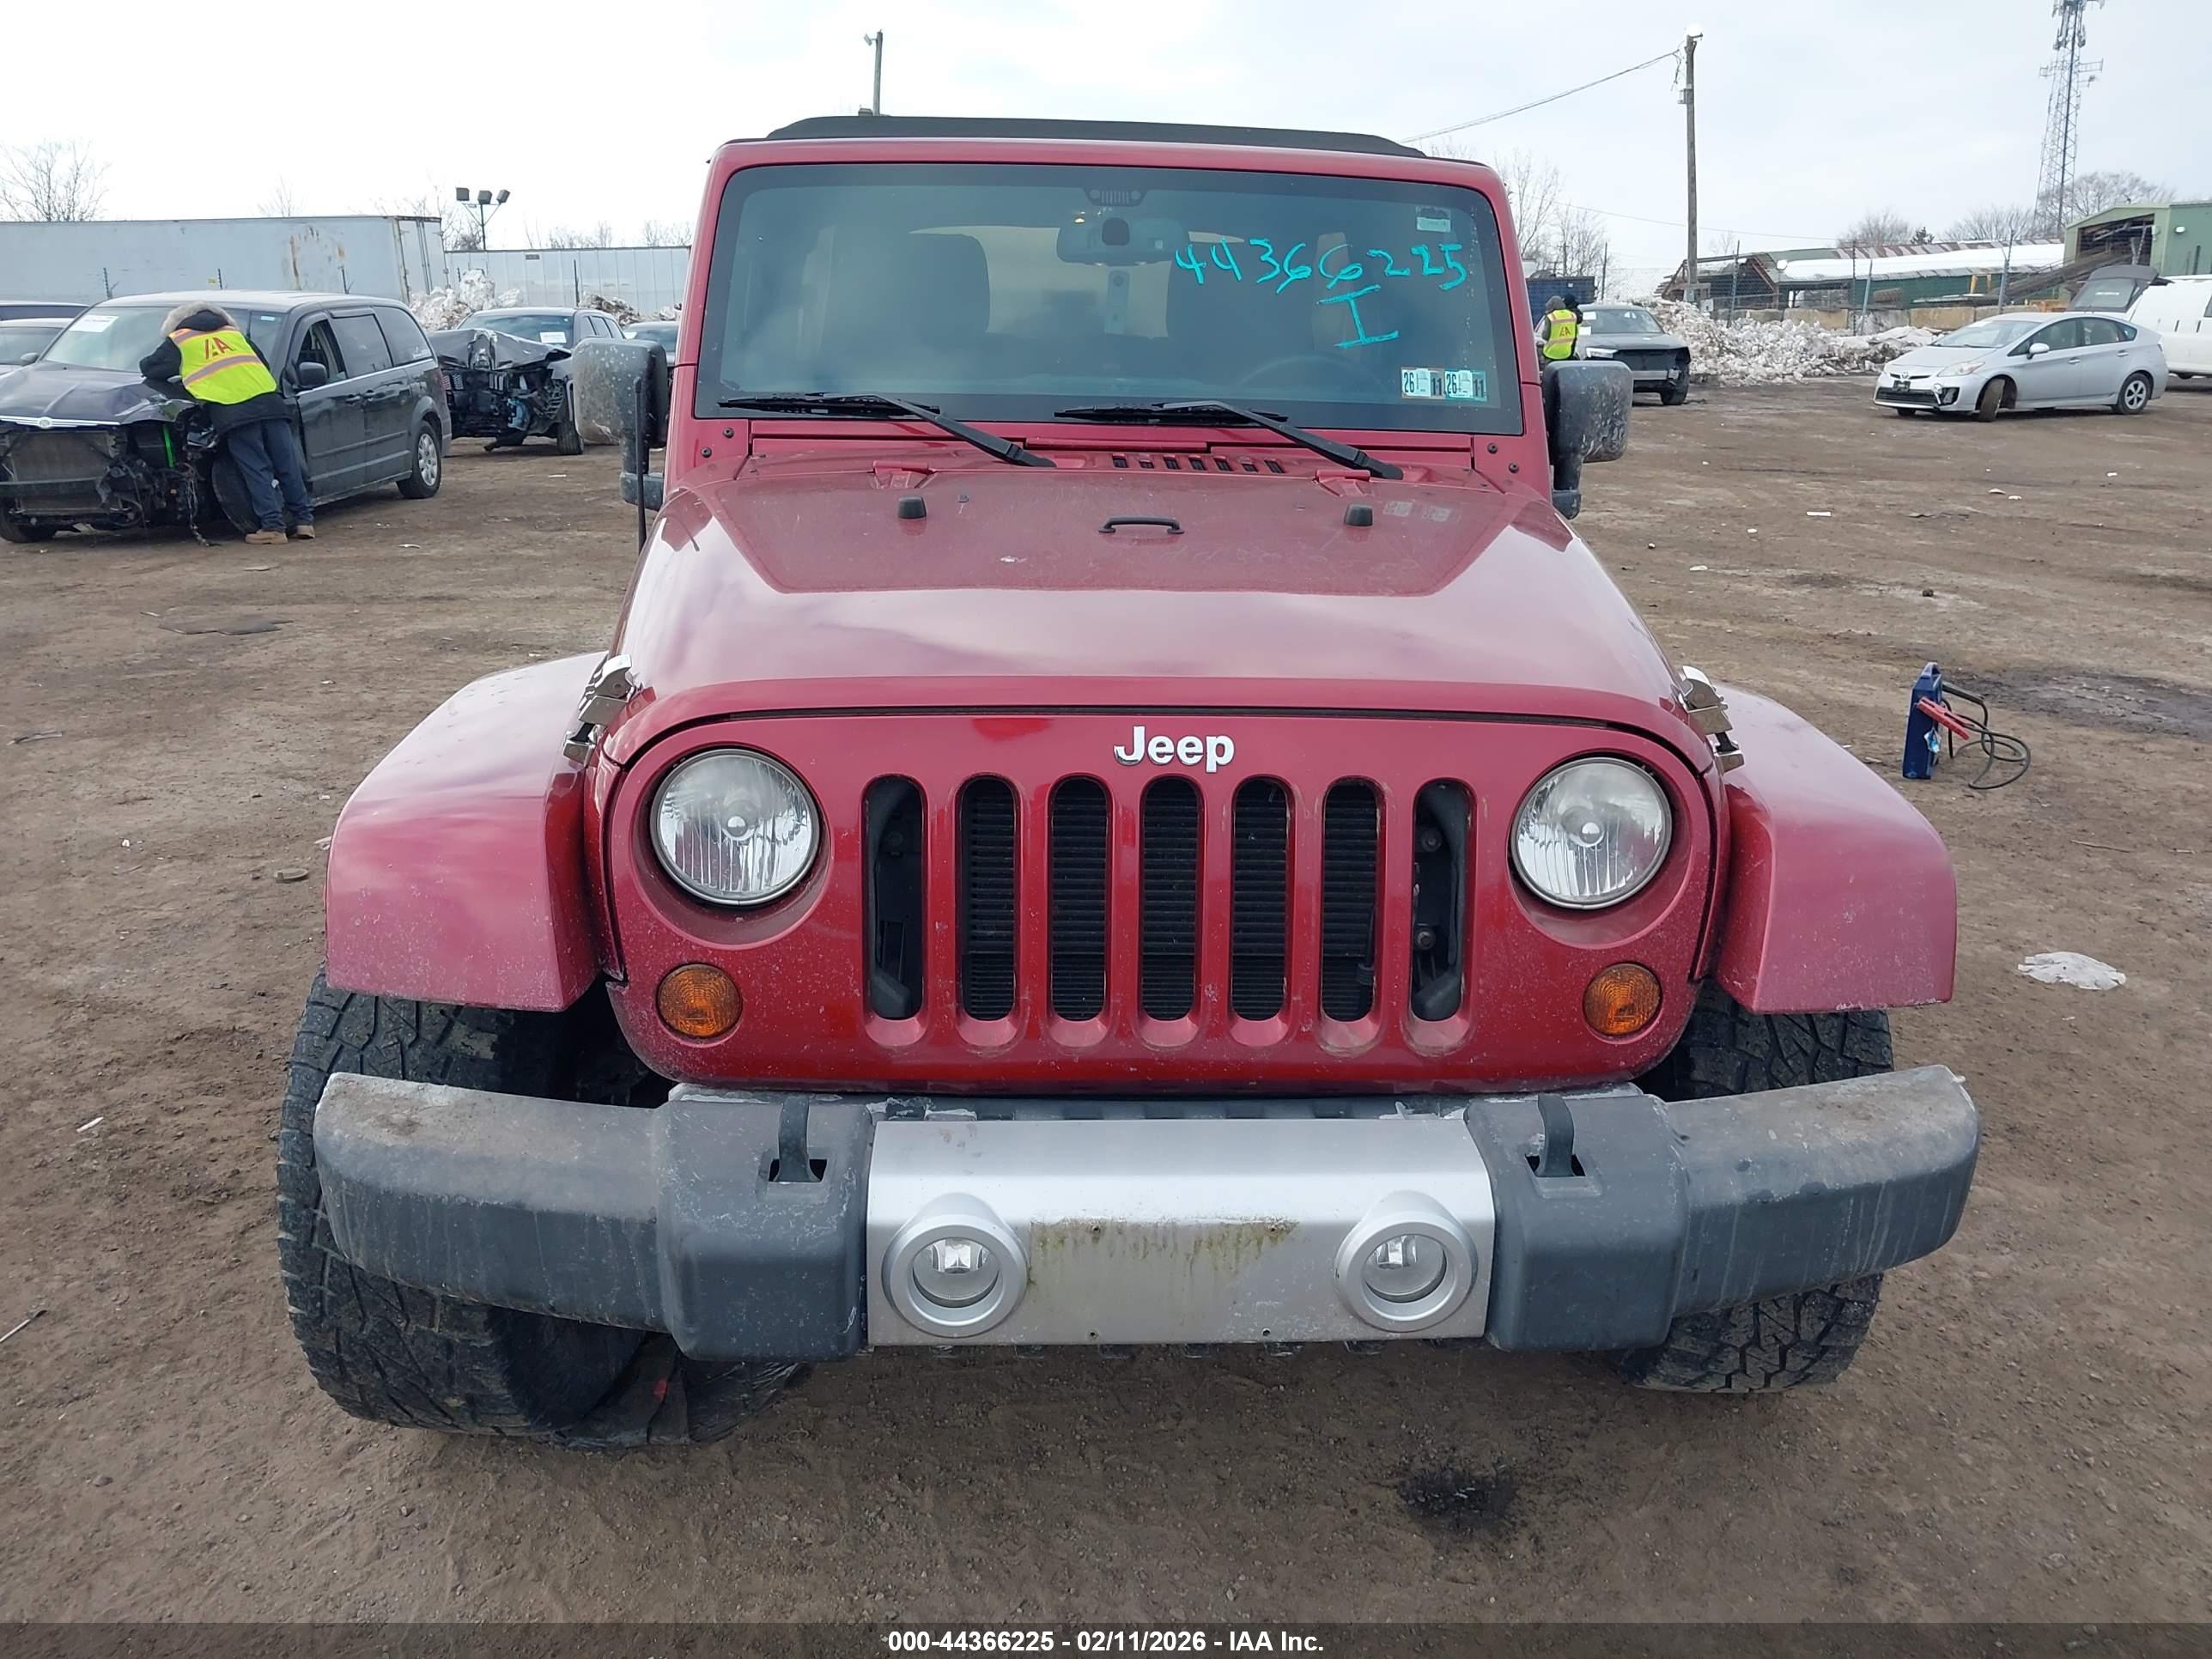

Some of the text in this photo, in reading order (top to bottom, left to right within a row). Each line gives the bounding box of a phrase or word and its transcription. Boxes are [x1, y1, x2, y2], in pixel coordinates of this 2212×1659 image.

[1175, 237, 1468, 294] 44366225
[1316, 284, 1400, 348] I
[1403, 372, 1415, 393] 26
[1431, 377, 1443, 396] 11
[1446, 374, 1457, 394] 26
[1473, 378, 1485, 398] 11
[1114, 726, 1235, 773] Jeep
